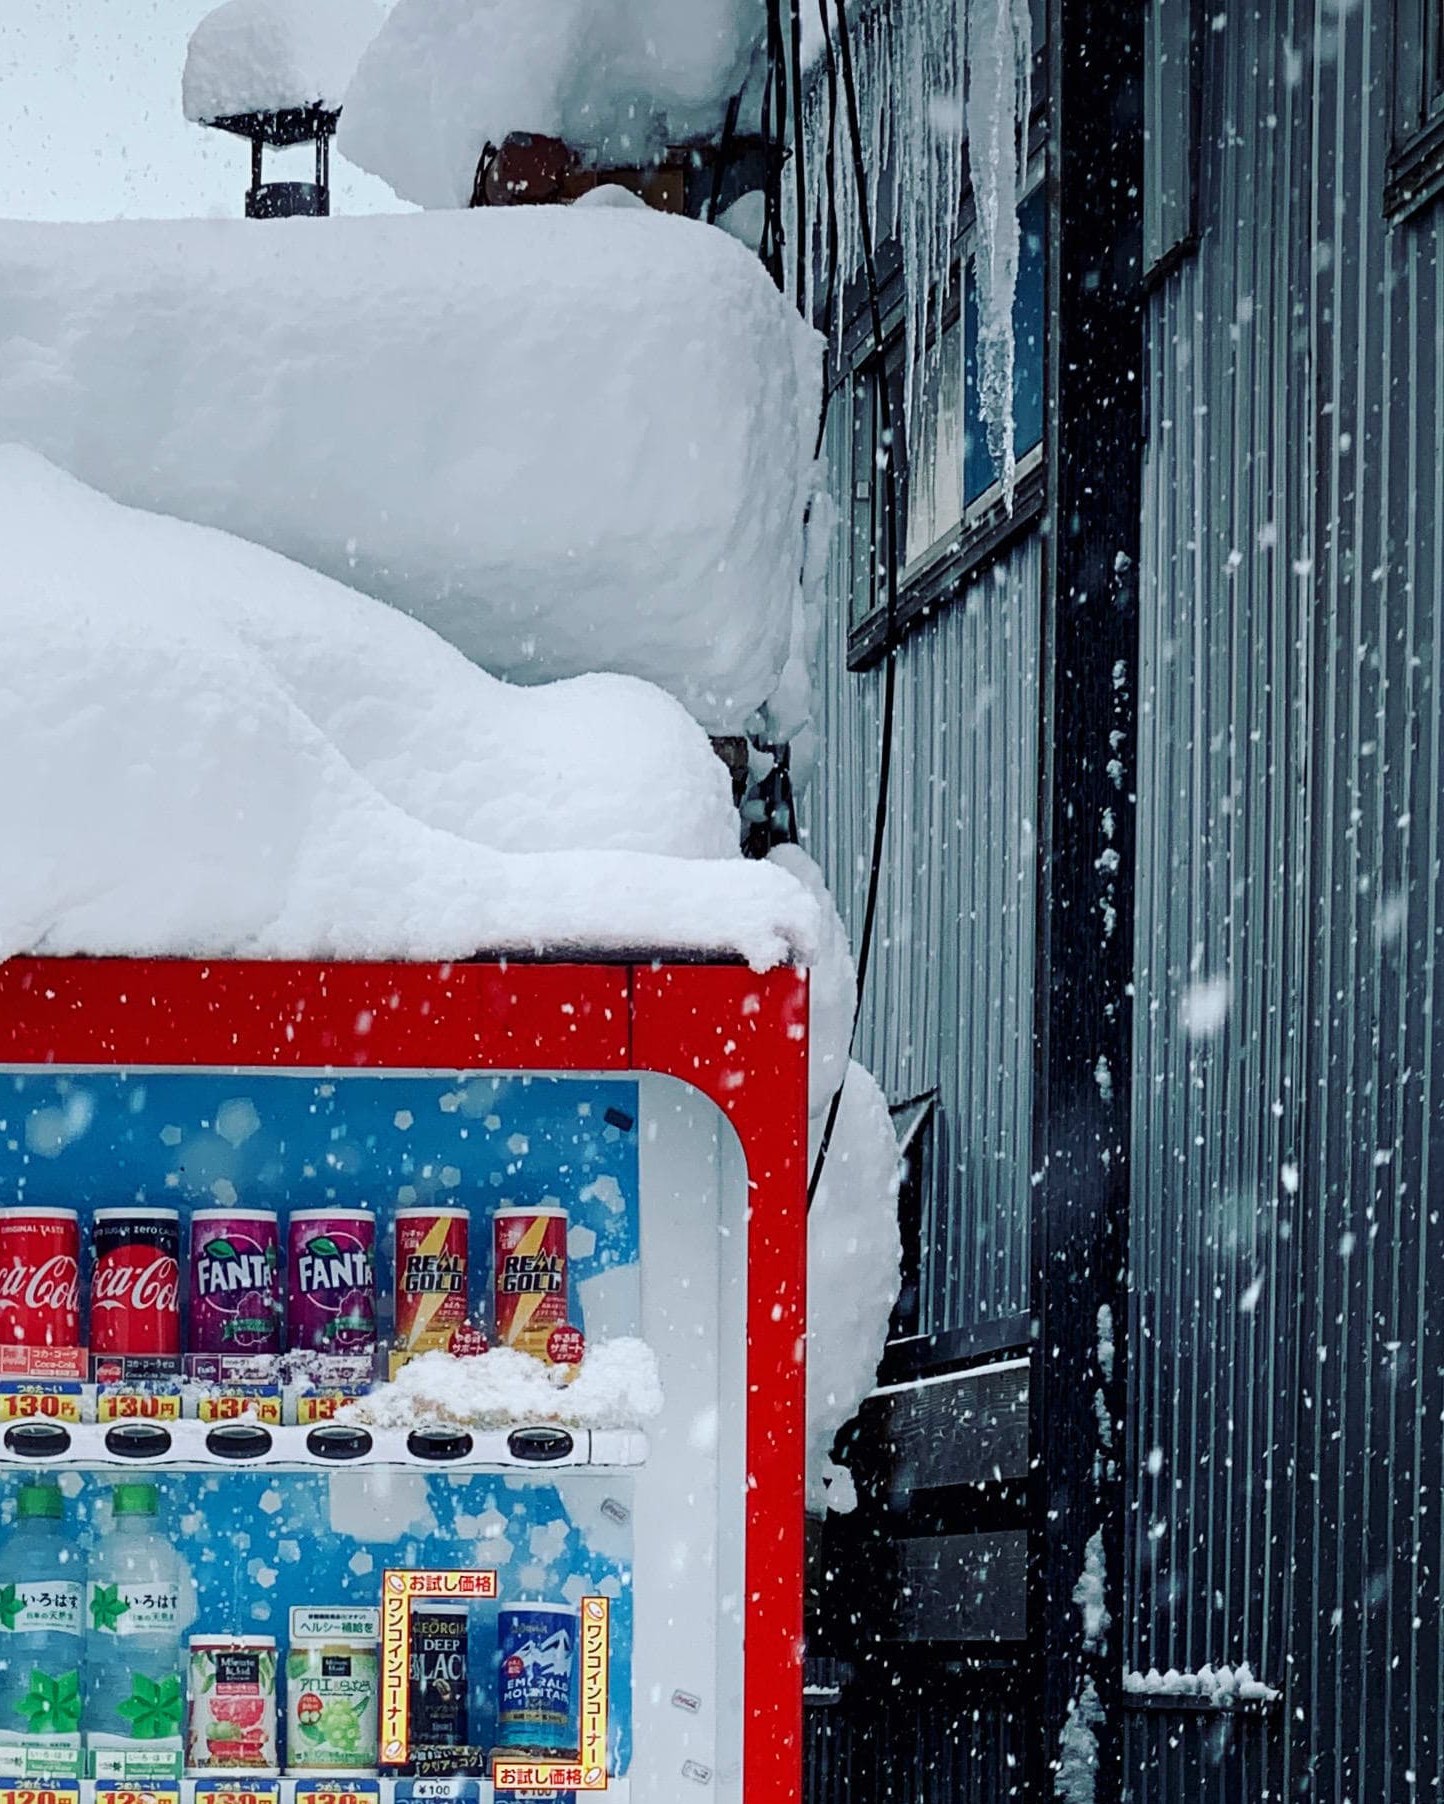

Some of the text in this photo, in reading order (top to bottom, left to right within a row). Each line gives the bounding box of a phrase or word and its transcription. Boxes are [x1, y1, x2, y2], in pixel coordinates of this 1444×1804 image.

[406, 1245, 462, 1274] REAL
[504, 1248, 562, 1275] REAL
[197, 1254, 273, 1296] FANTA
[298, 1252, 374, 1292] FANTA
[405, 1273, 462, 1293] GOLD
[502, 1273, 561, 1294] GOLD
[3, 1394, 76, 1417] 130円
[106, 1394, 176, 1418] 130円
[206, 1396, 278, 1420] 13円
[409, 1574, 492, 1592] お試し価格
[20, 1592, 78, 1610] いろはす
[124, 1593, 177, 1611] いろはす
[423, 1638, 461, 1652] DEEP
[387, 1597, 403, 1738] ワンコインコーナー
[586, 1624, 603, 1764] ワンコインコーナー
[499, 1769, 583, 1787] お試し価格
[418, 1784, 451, 1797] ¥100
